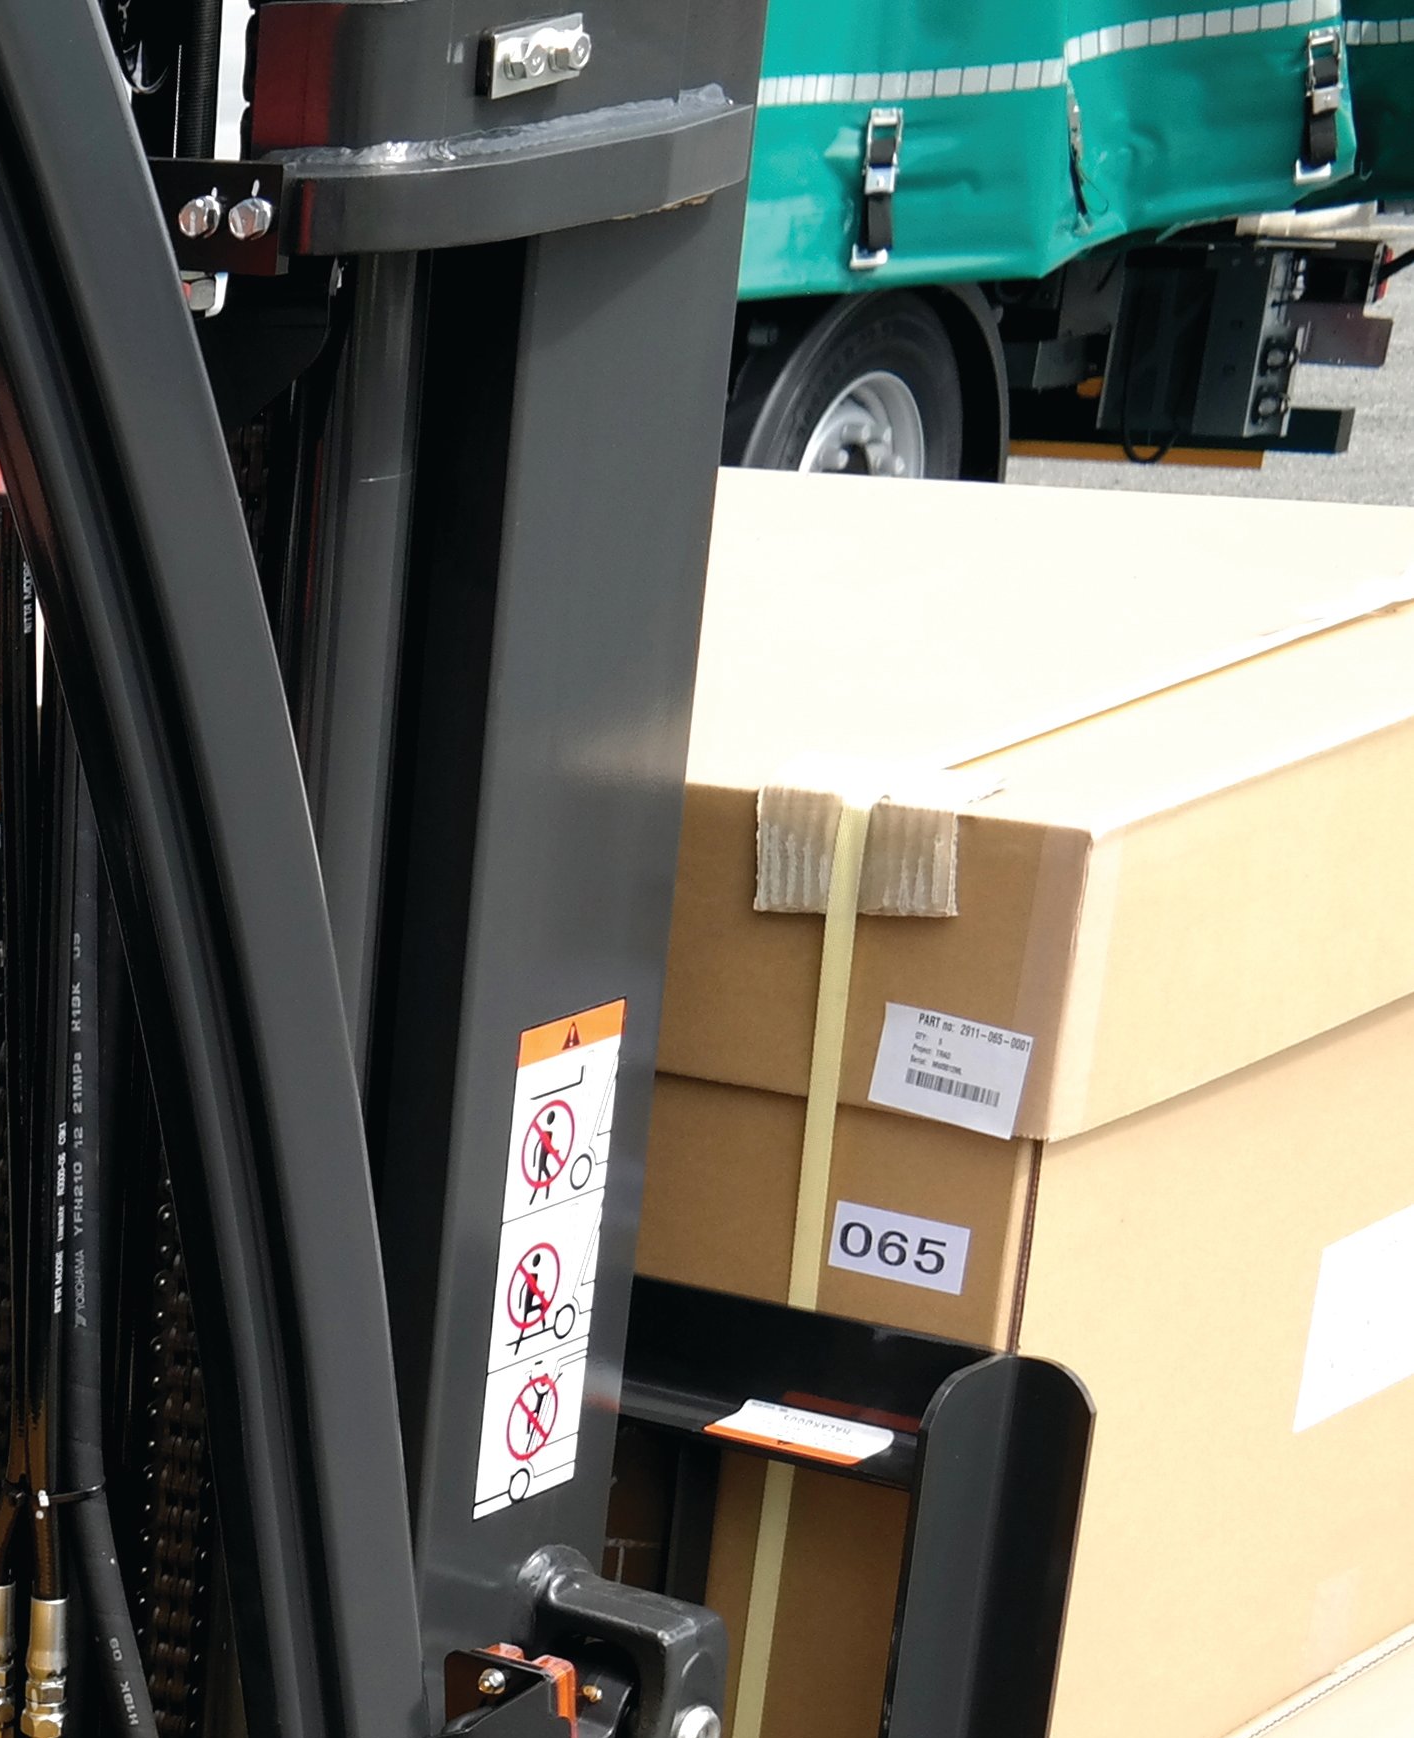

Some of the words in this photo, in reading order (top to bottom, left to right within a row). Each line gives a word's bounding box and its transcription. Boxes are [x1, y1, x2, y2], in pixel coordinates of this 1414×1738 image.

[918, 1013, 941, 1028] PART
[960, 1024, 1030, 1052] 2911-065-0001
[72, 1051, 82, 1113] 21MPa
[73, 1126, 83, 1147] 12
[73, 1161, 83, 1236] YFH210
[839, 1222, 947, 1275] 065
[74, 1249, 85, 1310] YOKOHAMA
